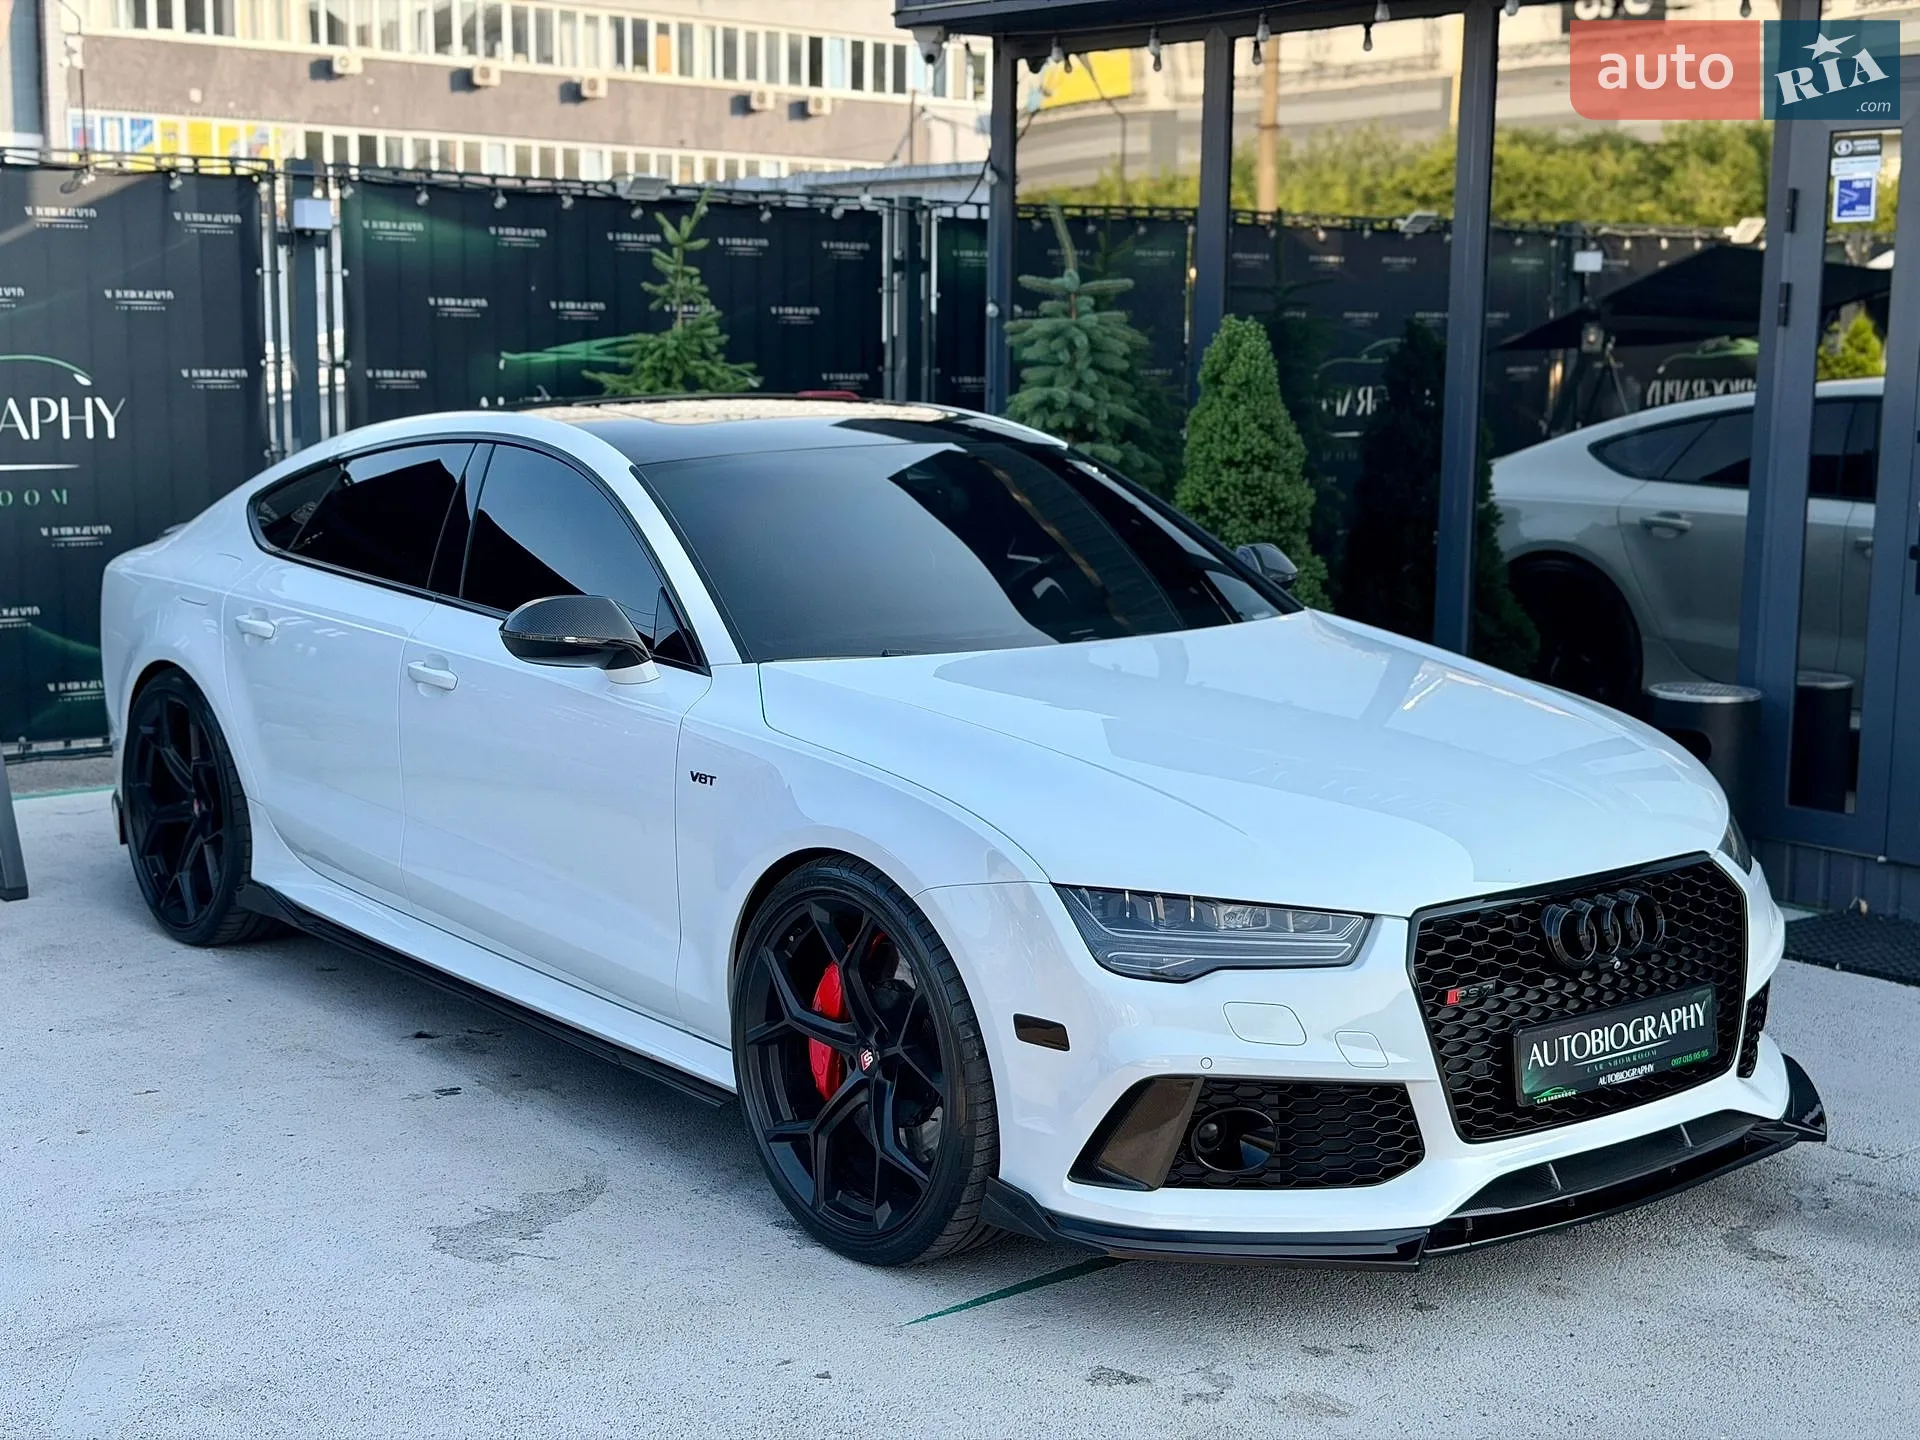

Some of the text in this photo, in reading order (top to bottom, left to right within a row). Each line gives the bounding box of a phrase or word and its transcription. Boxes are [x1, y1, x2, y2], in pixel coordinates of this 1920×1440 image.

[690, 770, 717, 786] V8T
[1528, 1001, 1706, 1070] AUTOBIOGRAPHY
[1598, 1063, 1655, 1085] AUTOBIOGRAPHY
